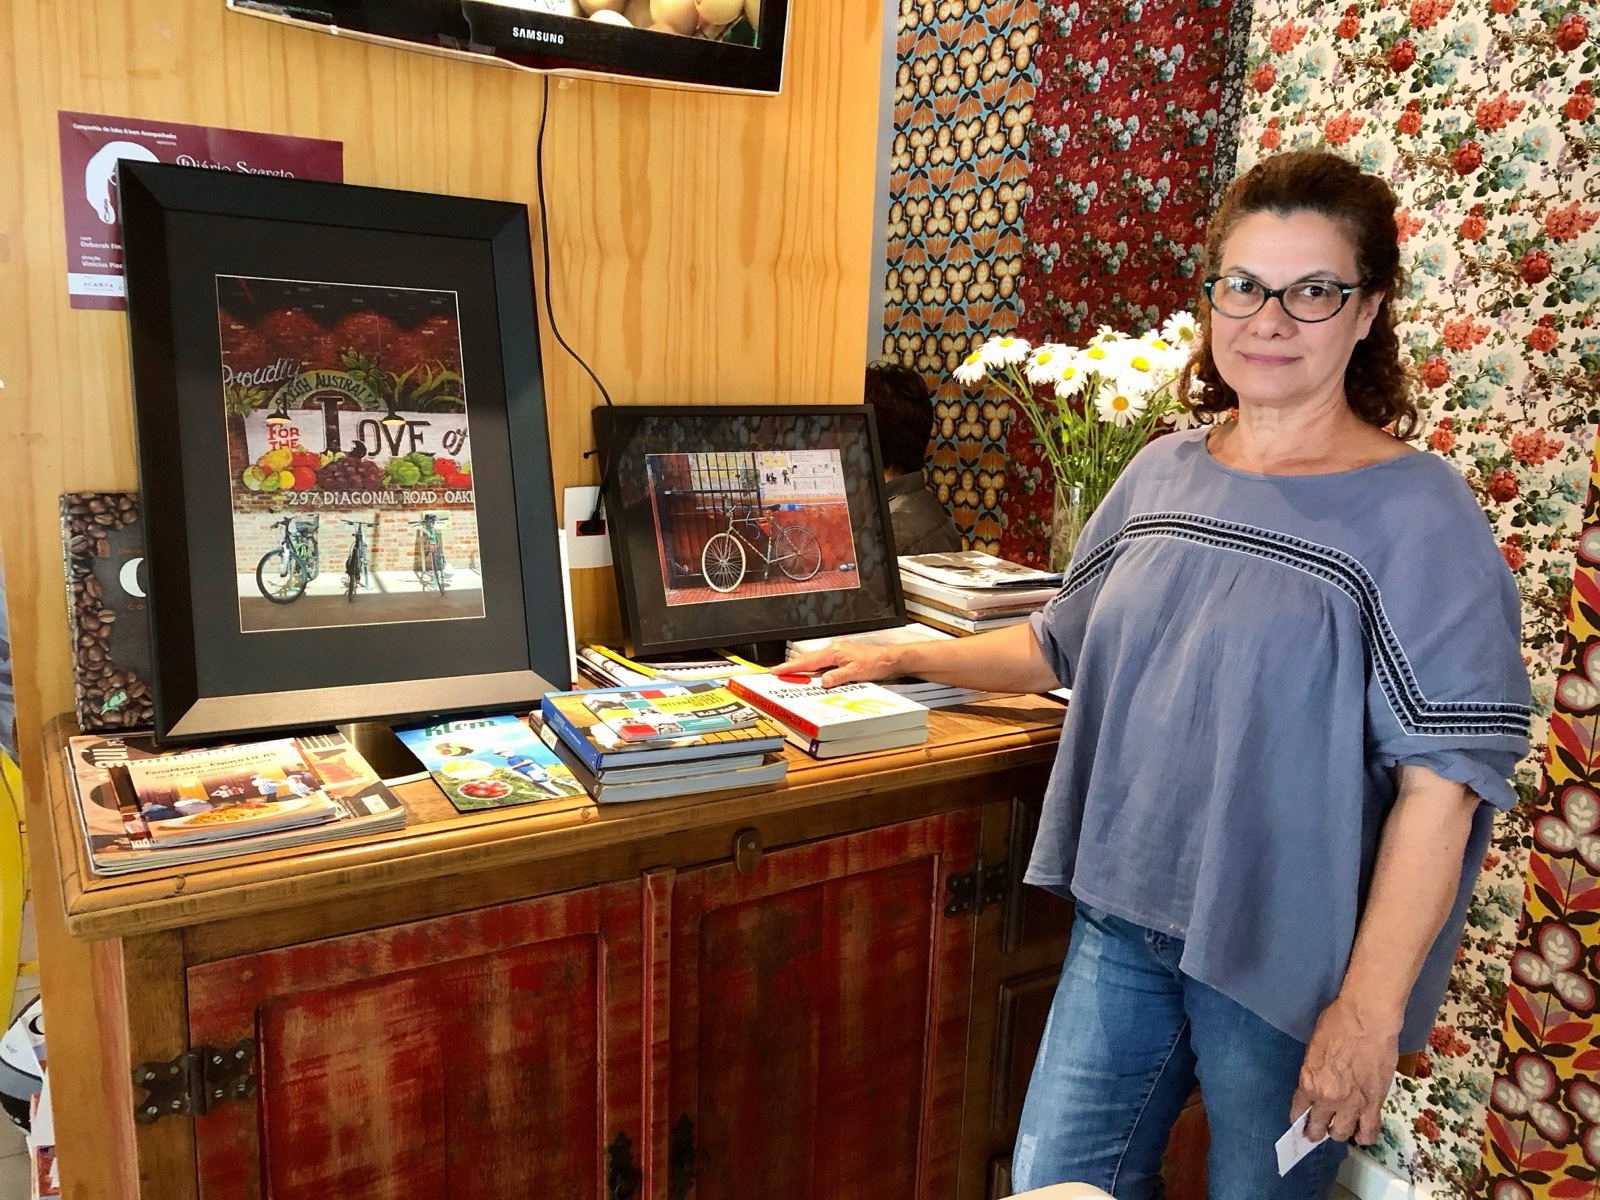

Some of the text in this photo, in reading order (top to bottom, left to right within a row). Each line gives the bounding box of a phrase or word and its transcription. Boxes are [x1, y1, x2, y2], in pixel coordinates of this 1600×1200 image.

[512, 26, 564, 45] SAMSUNG
[80, 241, 110, 249] Deborah
[266, 422, 300, 441] FOR
[313, 396, 437, 458] LOVE
[269, 438, 299, 450] THE
[402, 490, 437, 504] ROAD
